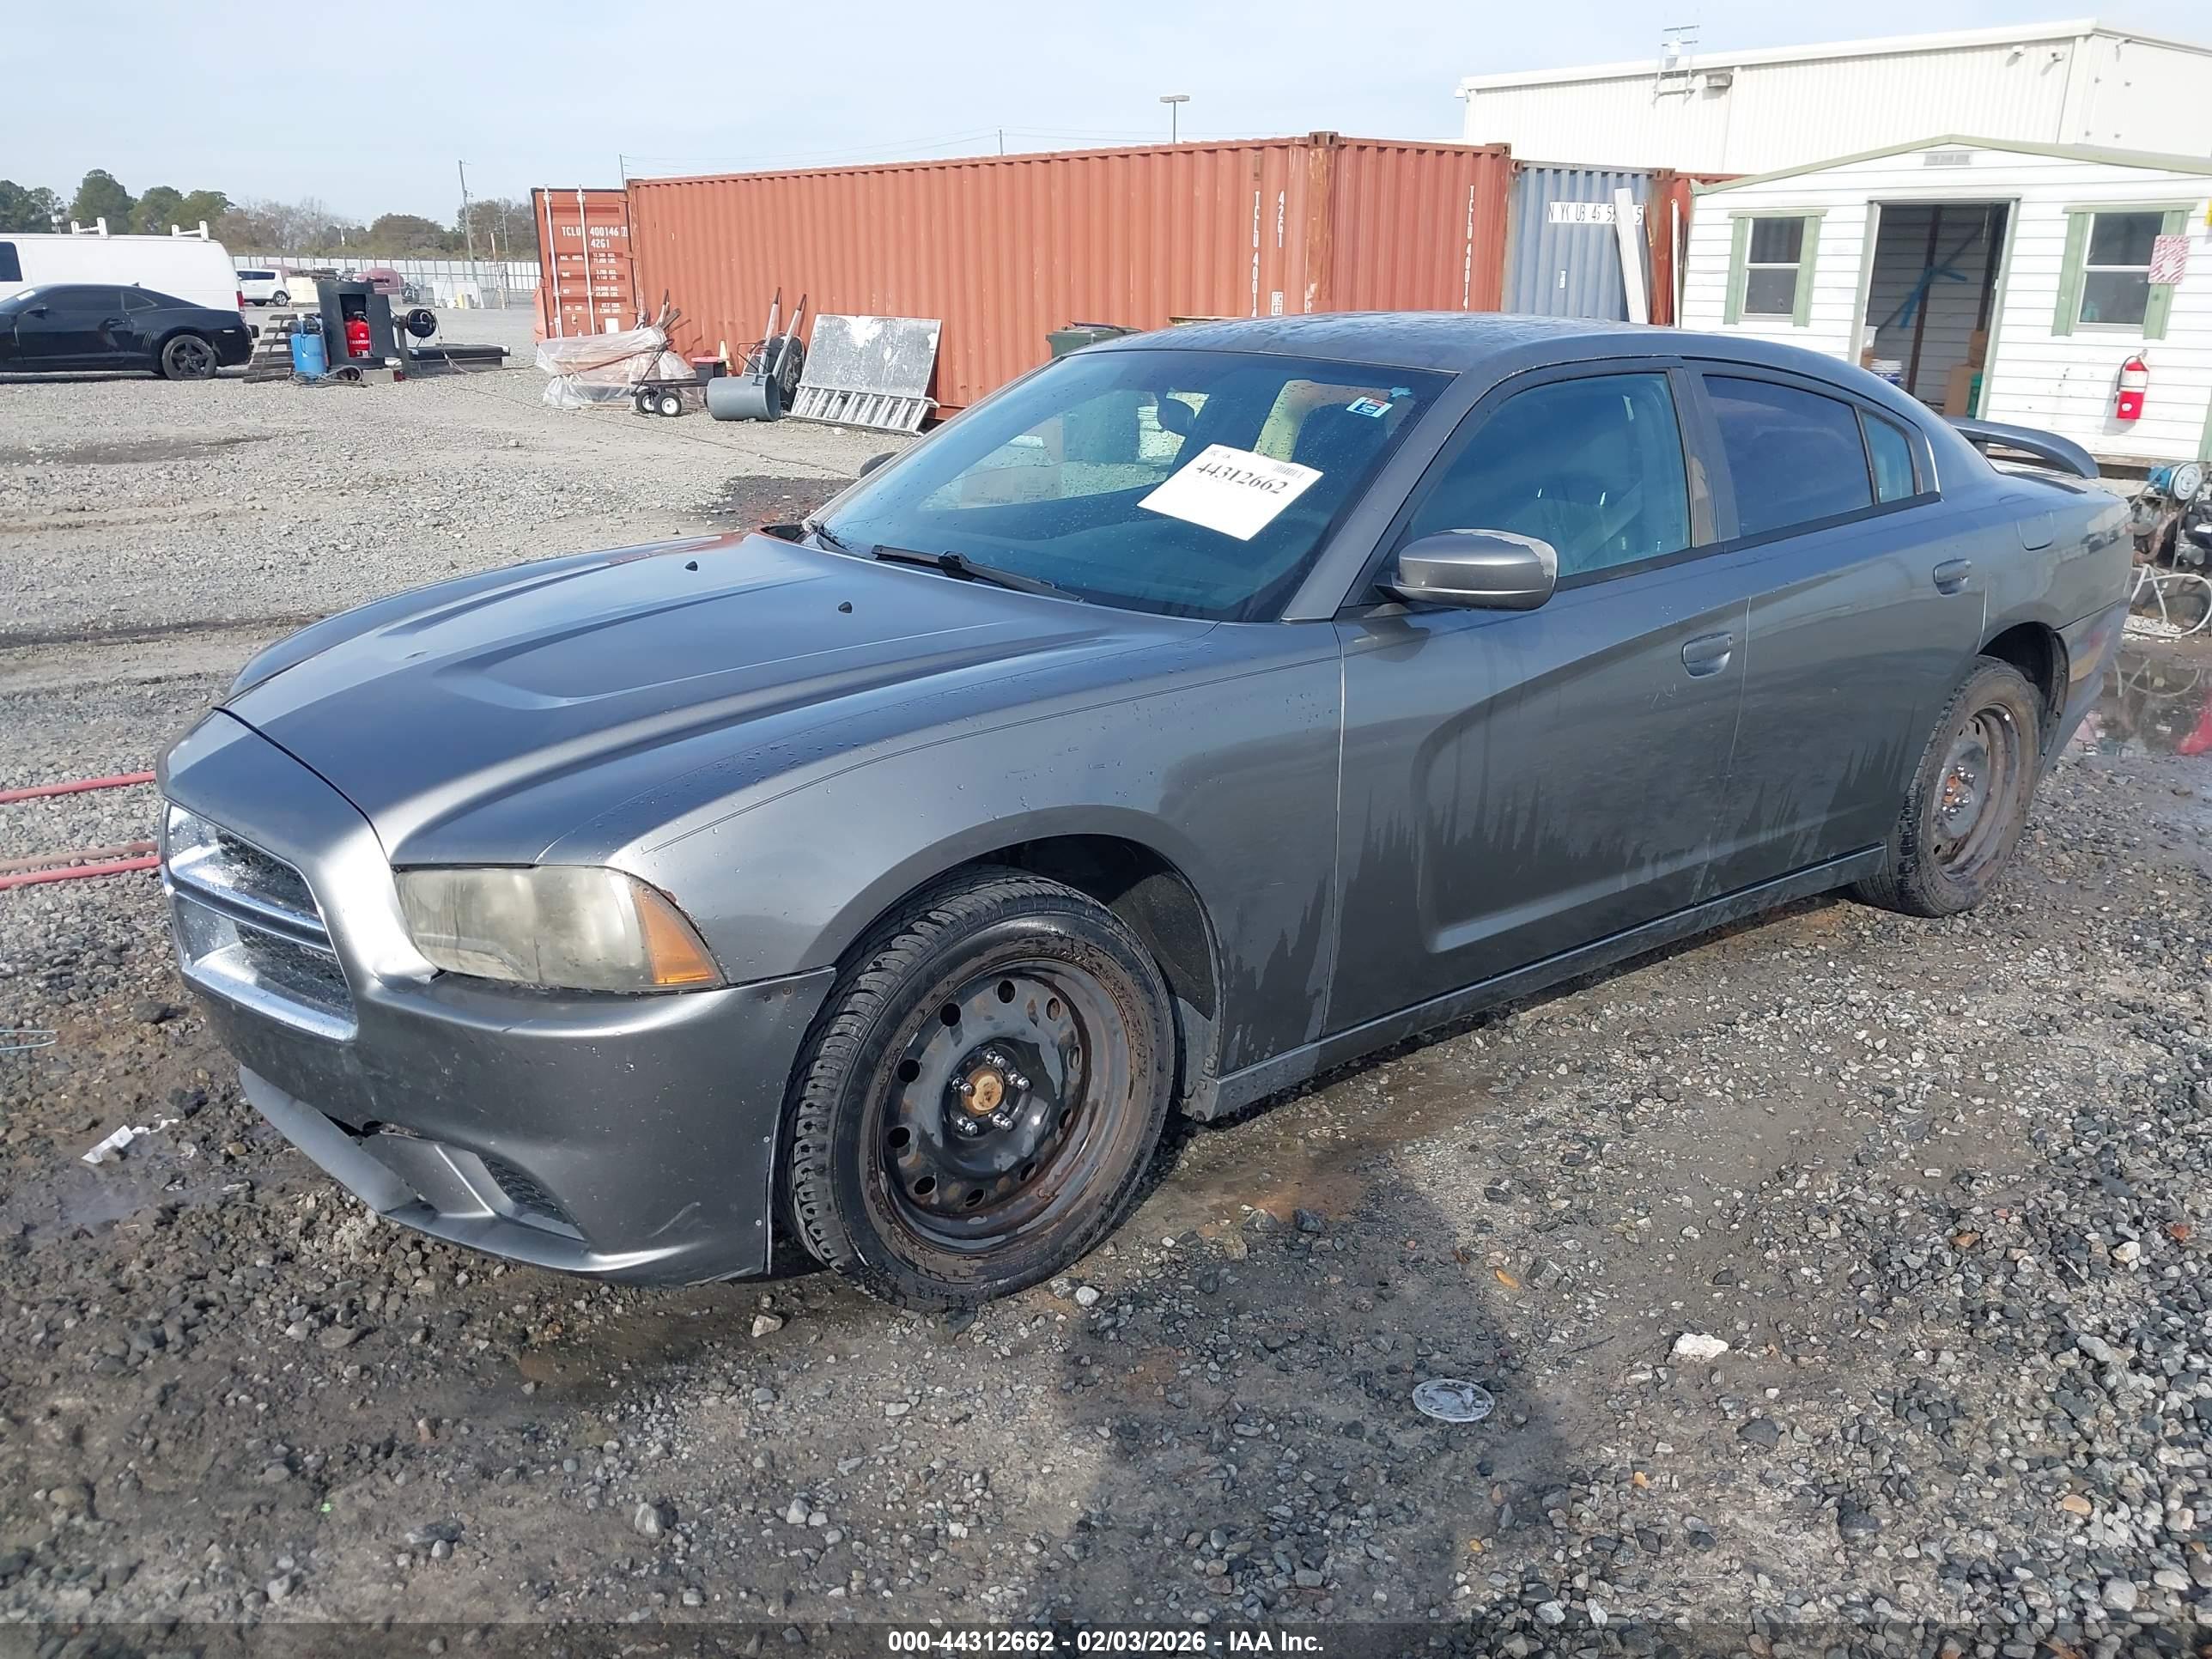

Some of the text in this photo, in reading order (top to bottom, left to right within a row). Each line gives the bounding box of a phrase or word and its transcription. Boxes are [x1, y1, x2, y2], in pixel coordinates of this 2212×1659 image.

[562, 226, 581, 237] TCLU
[590, 226, 619, 237] 400146
[1196, 462, 1288, 494] 44312662
